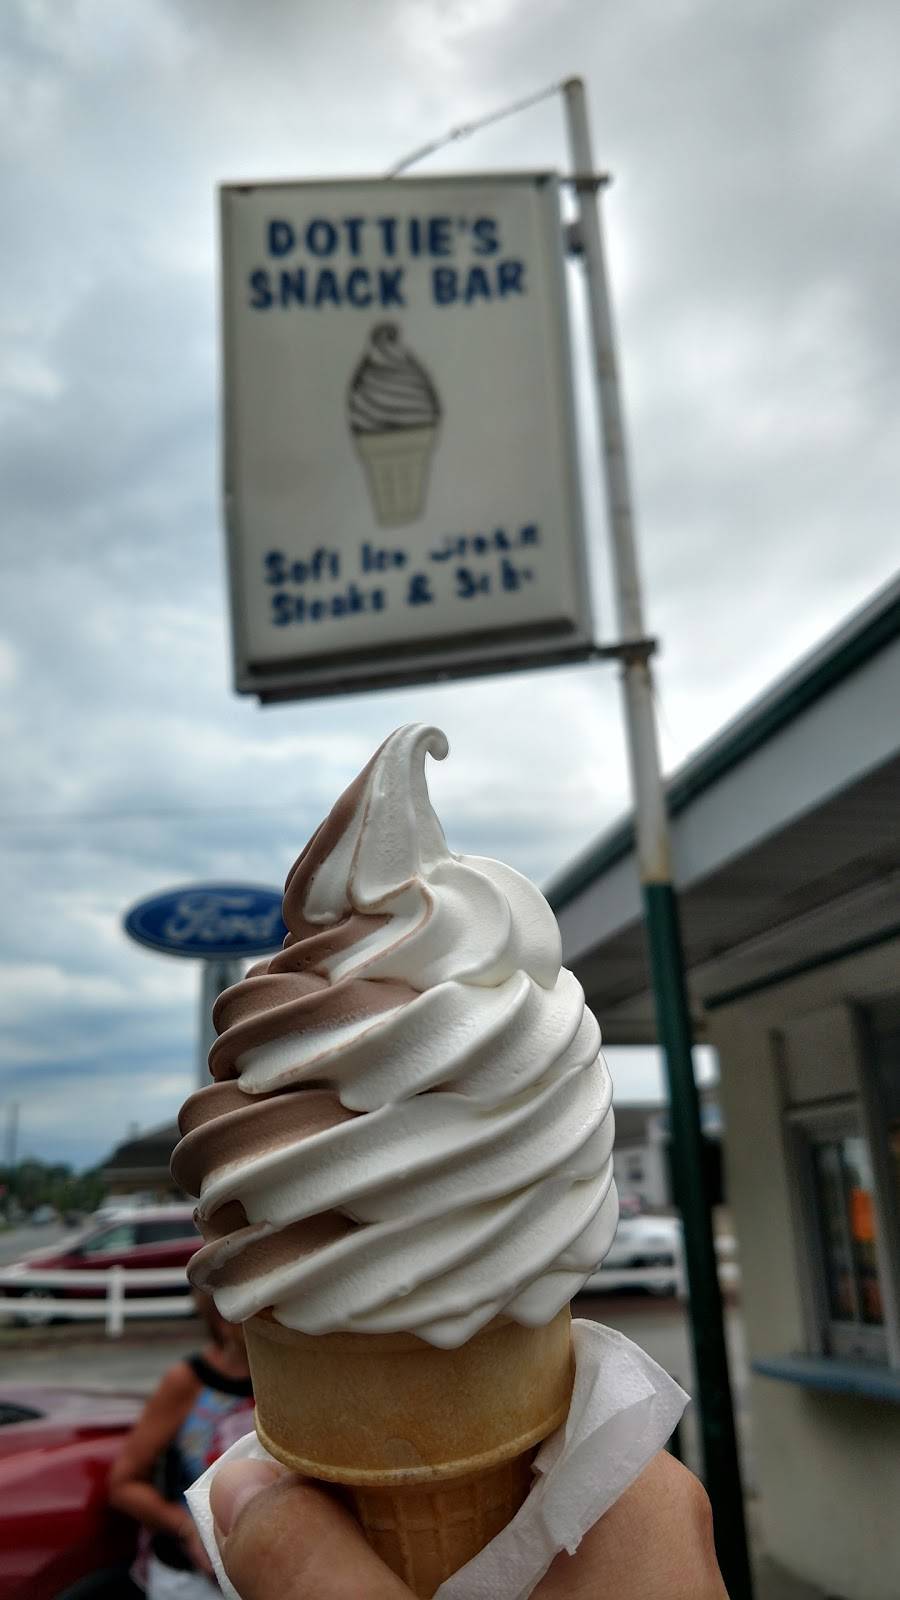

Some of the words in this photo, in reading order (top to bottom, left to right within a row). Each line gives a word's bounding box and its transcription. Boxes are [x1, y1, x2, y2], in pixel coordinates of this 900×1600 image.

[267, 216, 500, 258] DOTTIE'S
[249, 266, 406, 310] SNACK
[432, 260, 525, 306] BAR
[264, 548, 340, 586] Soft
[272, 582, 385, 627] Steaks
[408, 574, 433, 605] &
[163, 891, 280, 941] Ford
